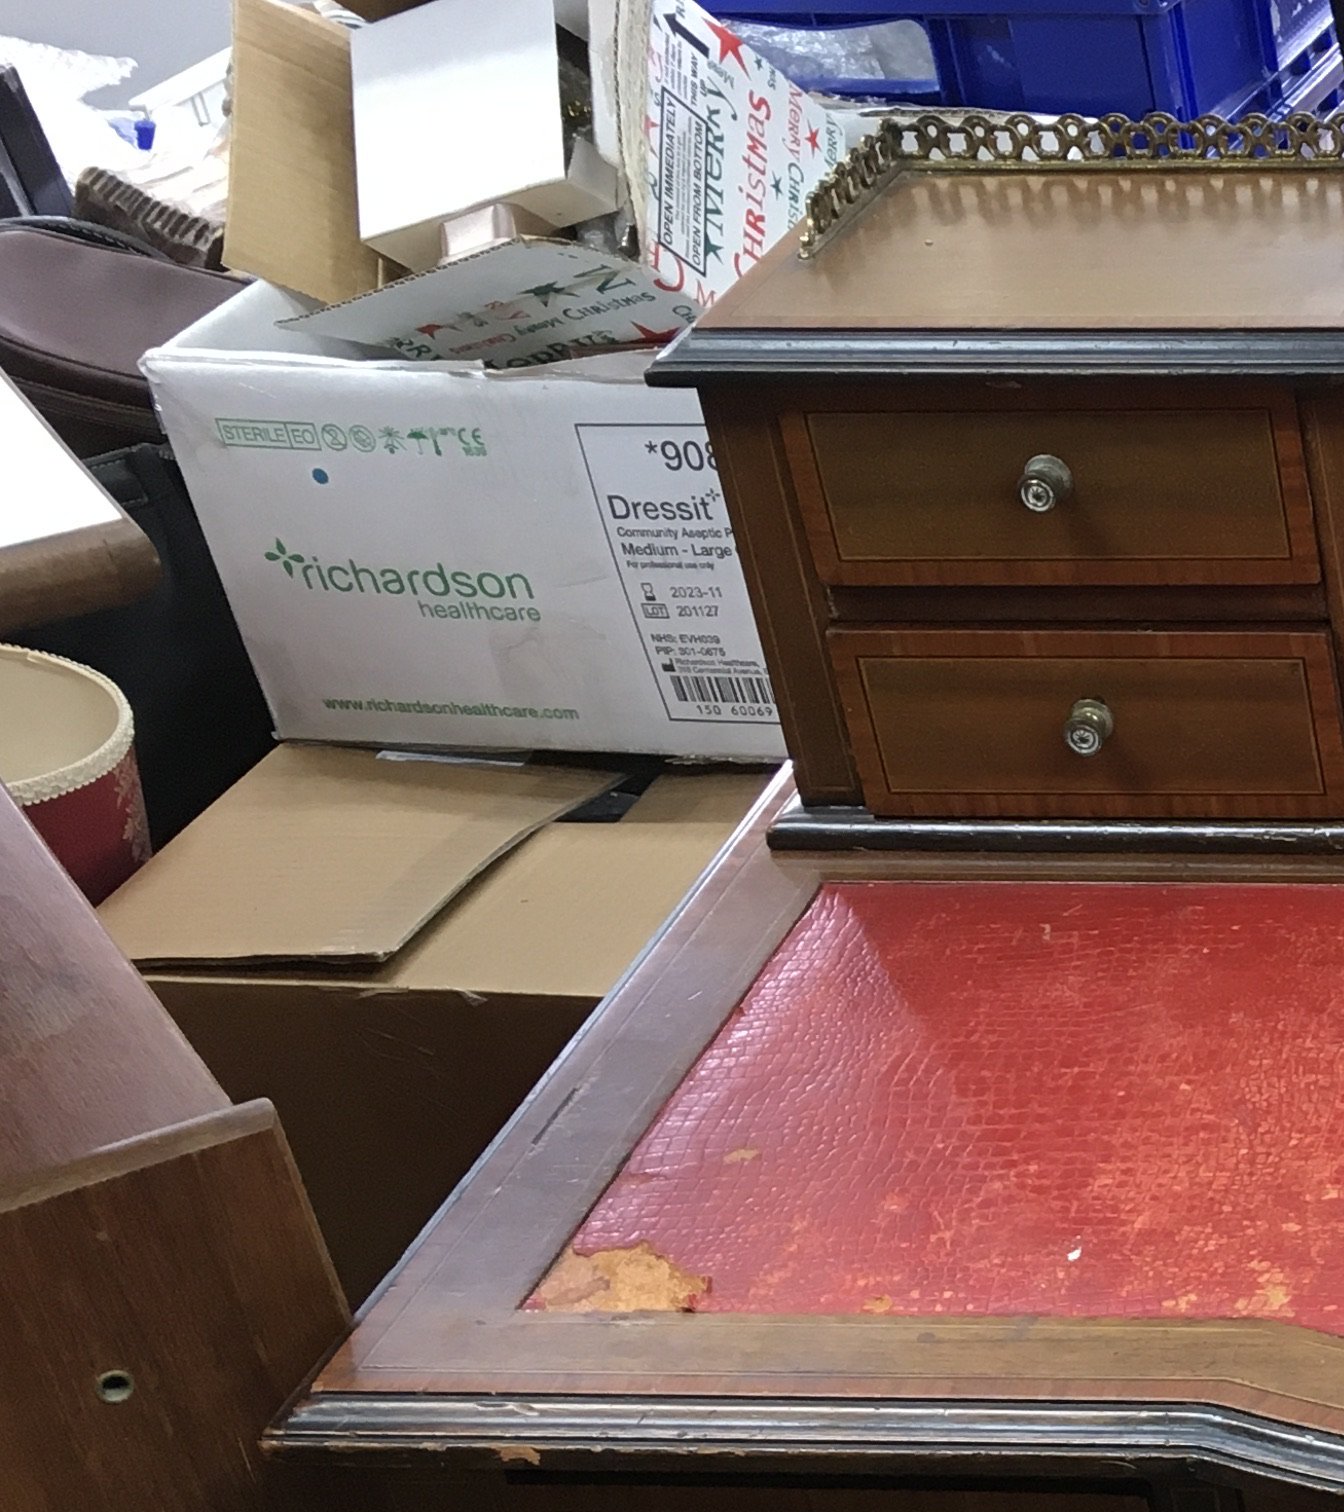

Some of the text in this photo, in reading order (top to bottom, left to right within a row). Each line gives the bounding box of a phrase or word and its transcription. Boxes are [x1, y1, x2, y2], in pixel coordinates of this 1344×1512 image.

[699, 79, 708, 97] UP
[664, 97, 677, 202] IMMEDIATELY
[692, 121, 704, 266] OPEN FROM BOTTOM
[663, 203, 674, 246] OPEN
[222, 425, 316, 445] STERILE EO
[607, 494, 713, 521] Dressit
[617, 527, 678, 540] Community
[681, 527, 721, 540] Aseptic
[621, 543, 678, 557] Medium
[690, 544, 732, 559] Large
[640, 561, 683, 570] professional
[699, 562, 715, 570] only
[302, 556, 535, 600] richardson
[670, 586, 723, 599] 2023-11
[418, 600, 541, 622] healthcare
[648, 605, 719, 618] LOT 201127
[322, 699, 581, 720] www.richardsonhealthcare.com
[696, 704, 773, 717] 150 60069
